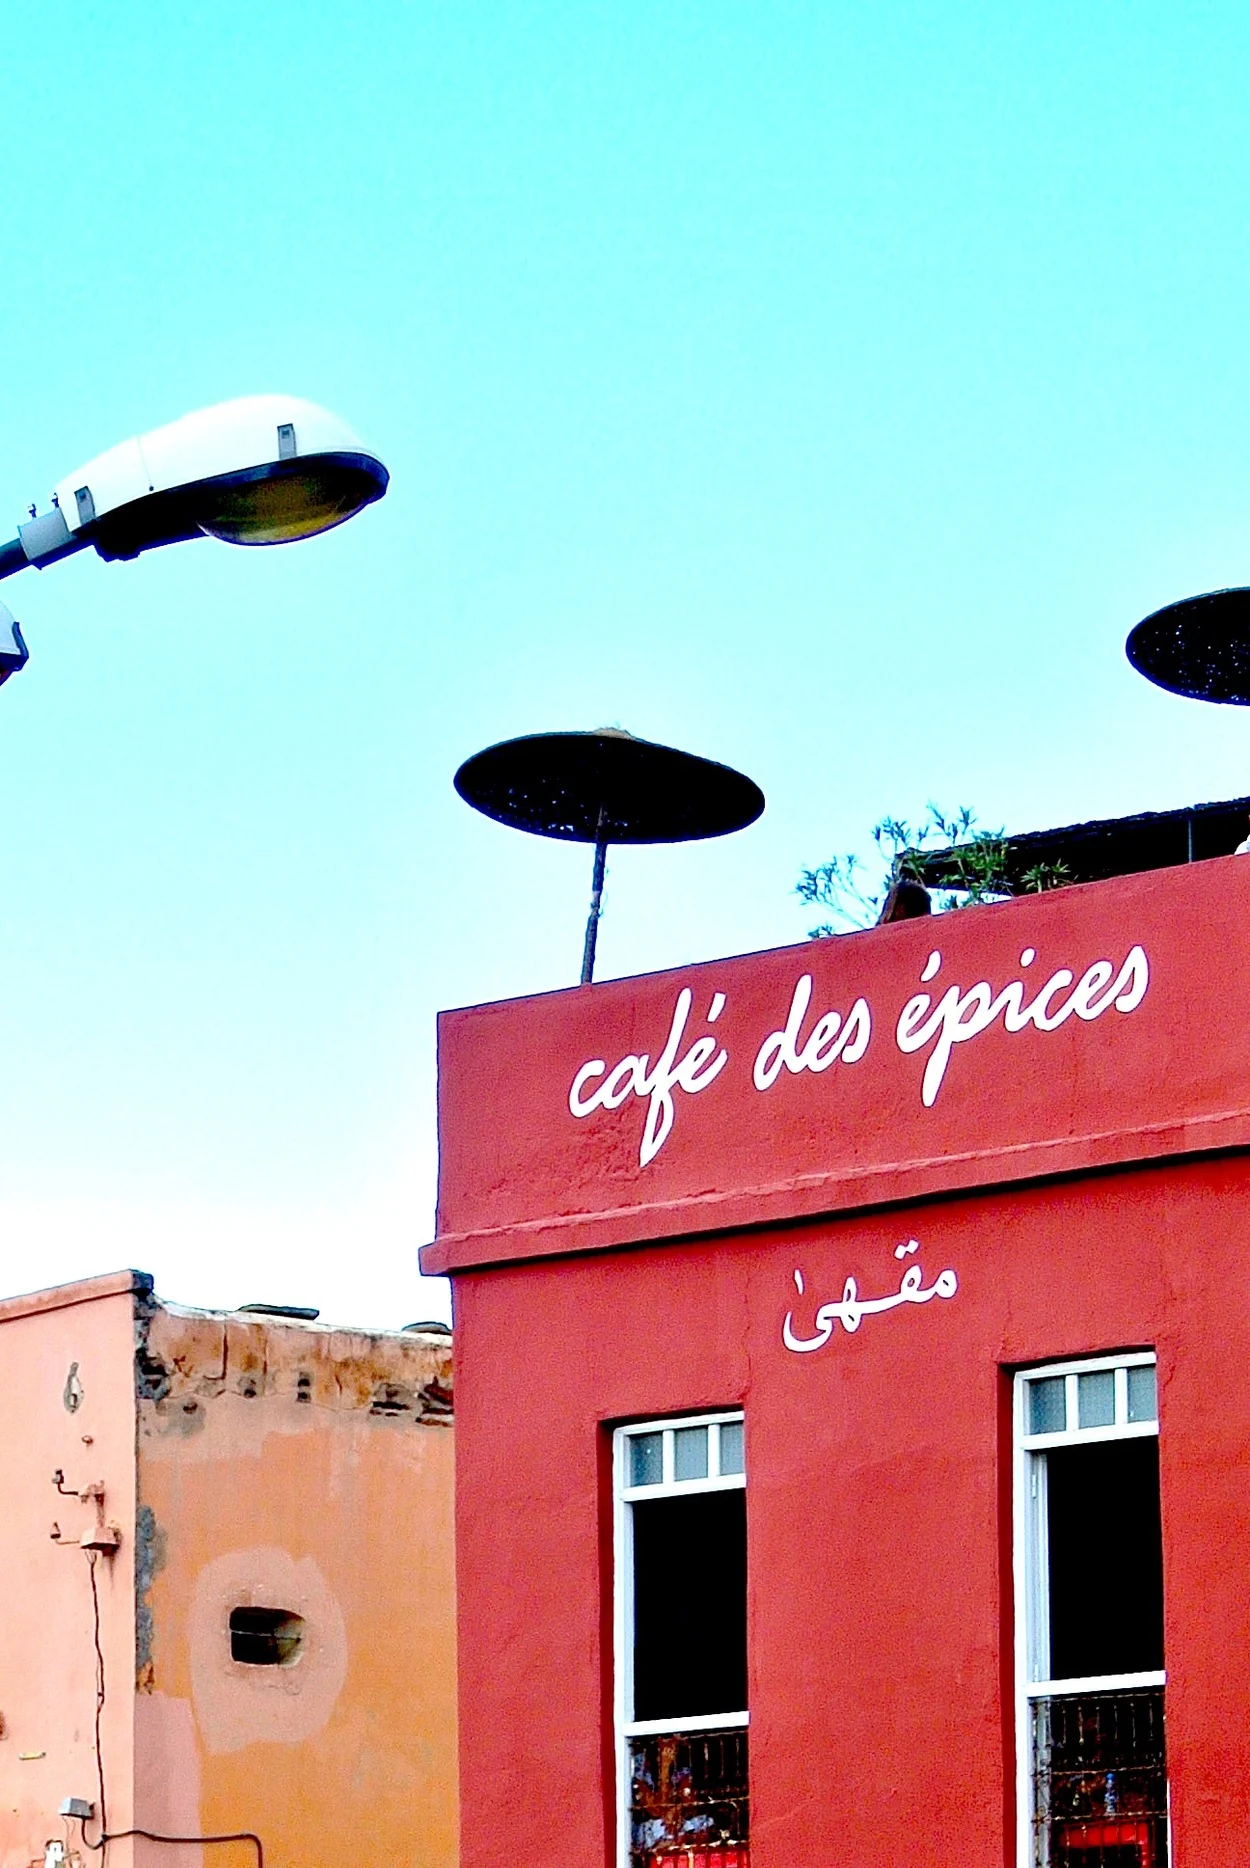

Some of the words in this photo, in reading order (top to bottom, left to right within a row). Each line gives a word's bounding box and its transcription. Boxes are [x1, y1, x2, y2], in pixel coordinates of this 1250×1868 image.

[568, 986, 729, 1168] café
[752, 973, 872, 1092] des
[895, 944, 1150, 1108] épices
